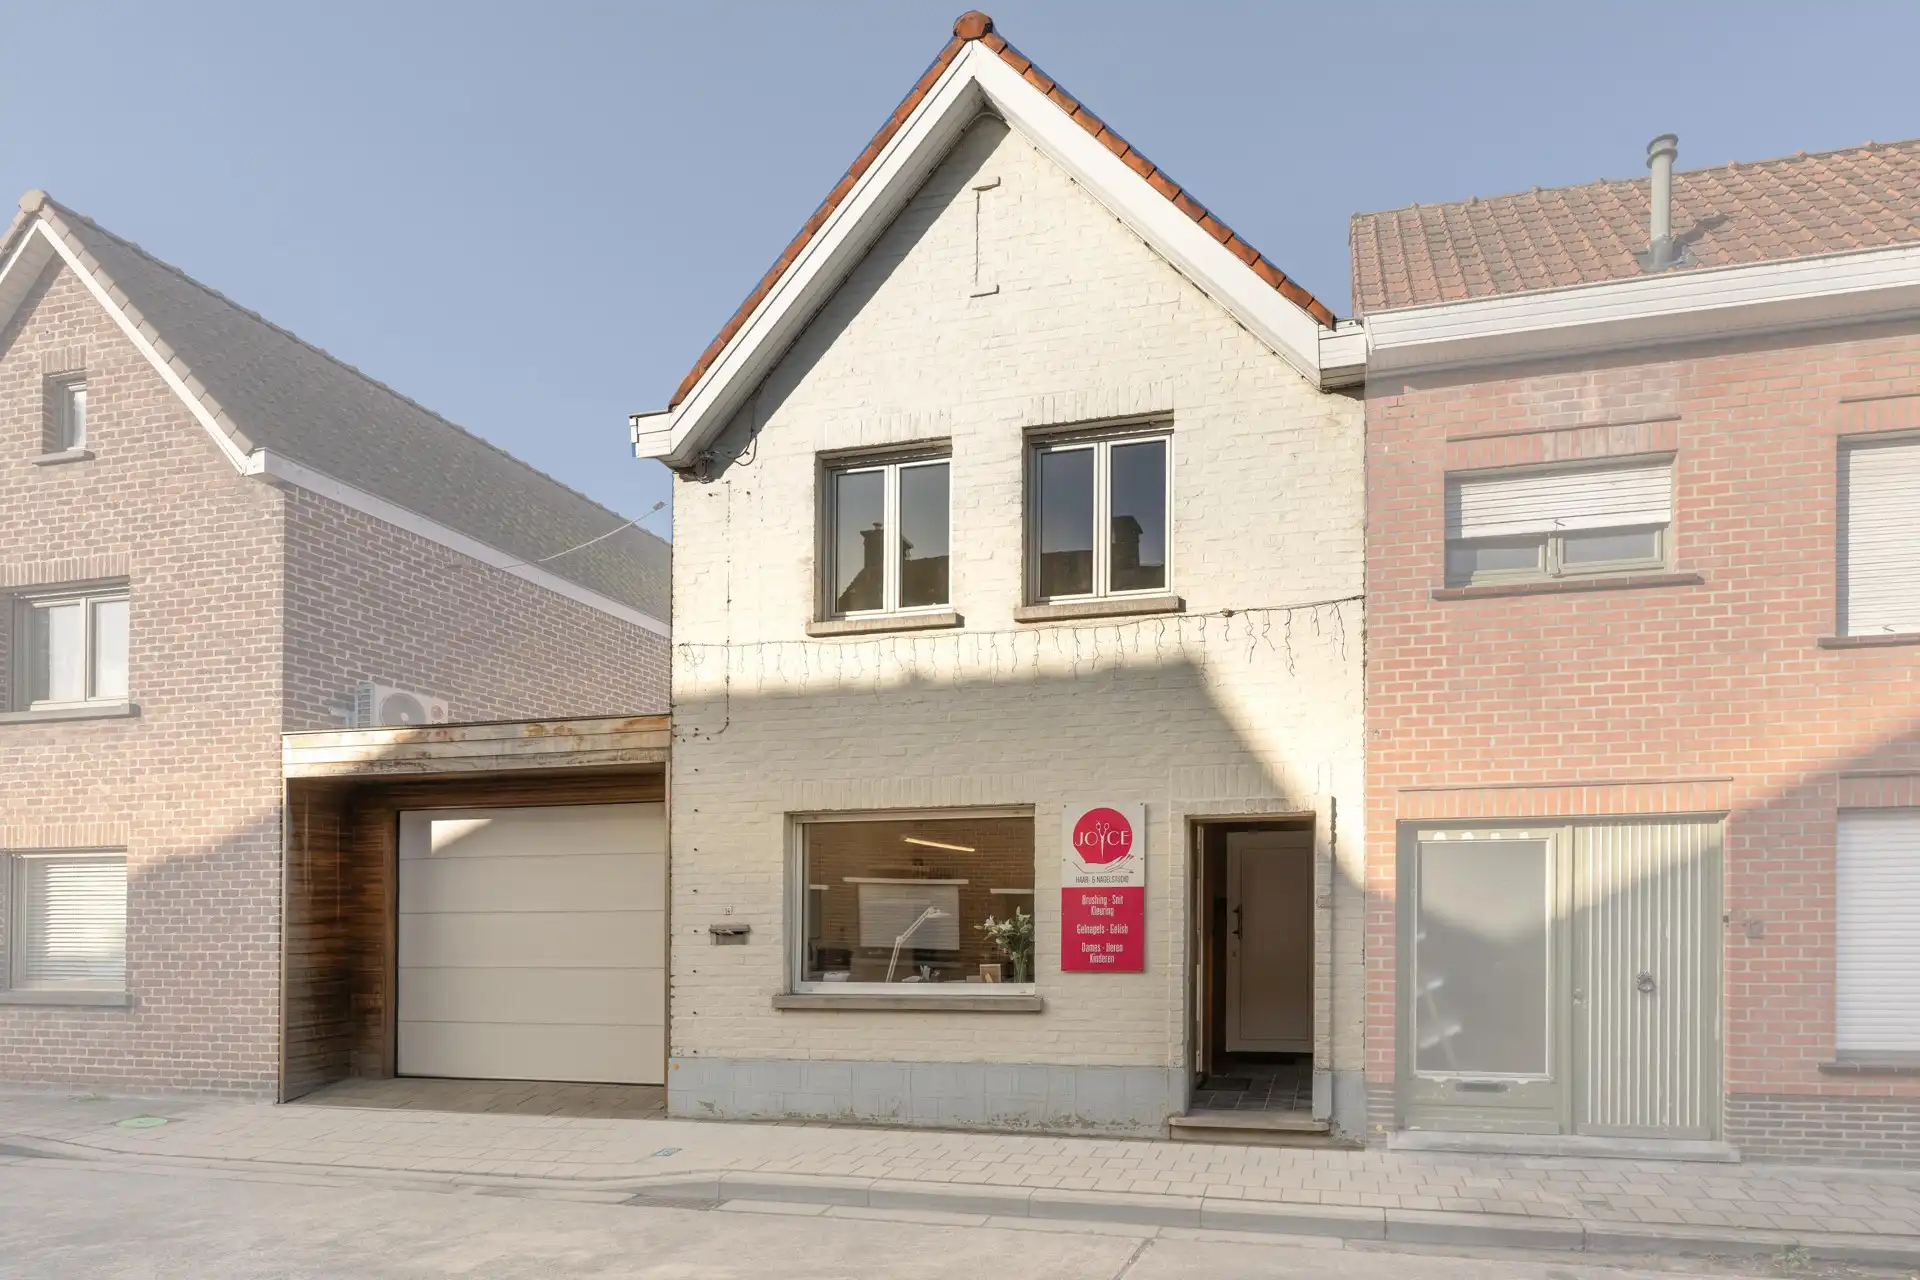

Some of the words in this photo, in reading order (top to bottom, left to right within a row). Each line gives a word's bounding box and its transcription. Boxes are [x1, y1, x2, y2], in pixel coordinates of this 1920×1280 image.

[1075, 821, 1130, 859] JOYCE
[1096, 875, 1129, 883] NAGELSTUDIO
[1082, 894, 1107, 906] Brushing
[1112, 894, 1123, 904] Snit
[1091, 906, 1114, 917] Kleuring
[1076, 924, 1104, 935] Gelnagels
[1110, 924, 1128, 934] Gelish
[1082, 942, 1100, 952] Dames
[1106, 942, 1123, 952] Heren
[1090, 953, 1114, 963] Kinderen
